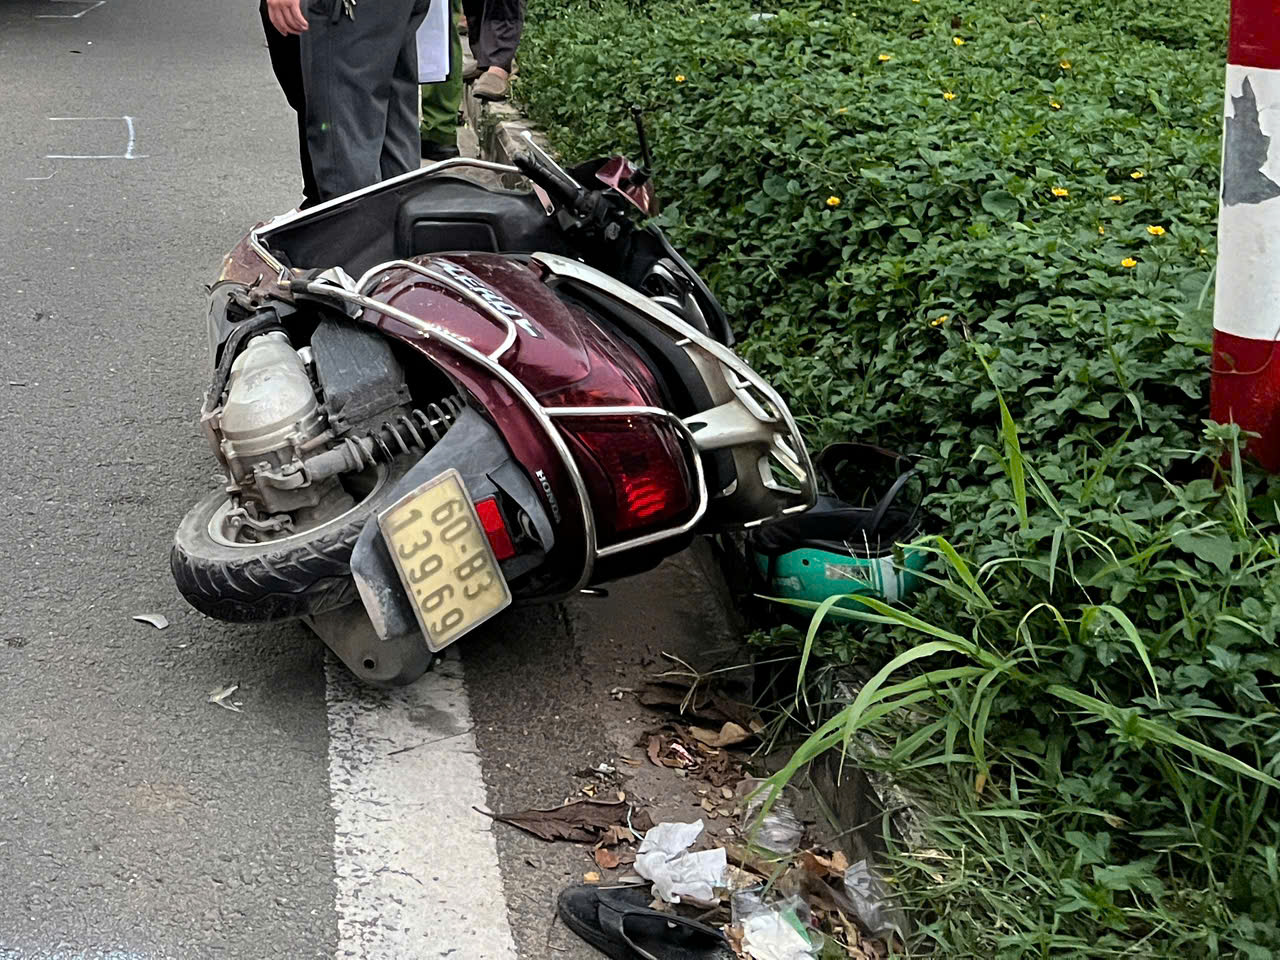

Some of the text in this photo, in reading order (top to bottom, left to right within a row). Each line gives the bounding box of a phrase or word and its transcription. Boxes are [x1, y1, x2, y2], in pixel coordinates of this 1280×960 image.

[535, 469, 561, 524] HONDA
[391, 509, 465, 637] 139.69
[430, 497, 494, 601] 60-B3
